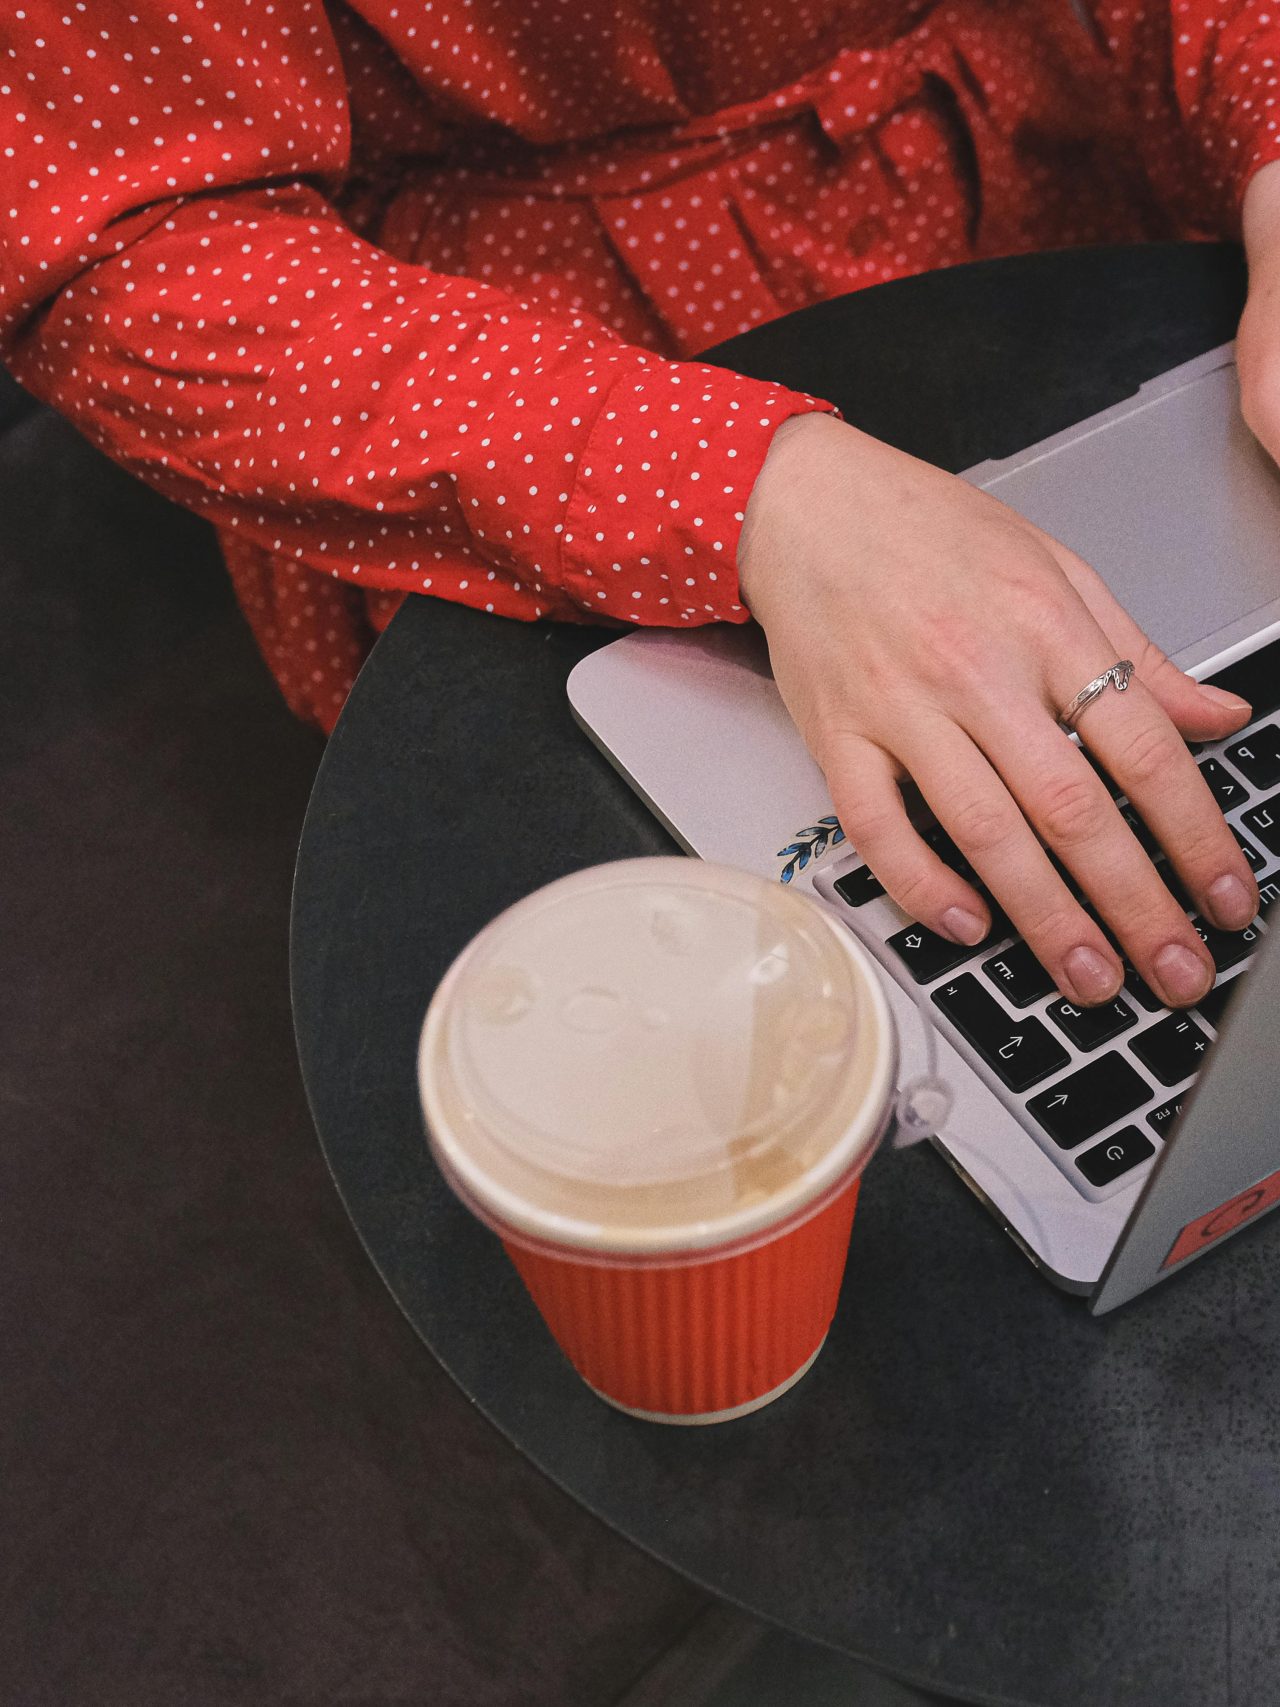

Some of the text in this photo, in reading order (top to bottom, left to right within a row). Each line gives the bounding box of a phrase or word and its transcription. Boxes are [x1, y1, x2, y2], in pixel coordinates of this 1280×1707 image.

[1237, 746, 1255, 759] Ь
[1252, 809, 1274, 829] Л
[1243, 927, 1257, 941] P
[994, 961, 1015, 980] Ё
[1060, 1003, 1082, 1017] Ъ
[1155, 1108, 1171, 1120] F12
